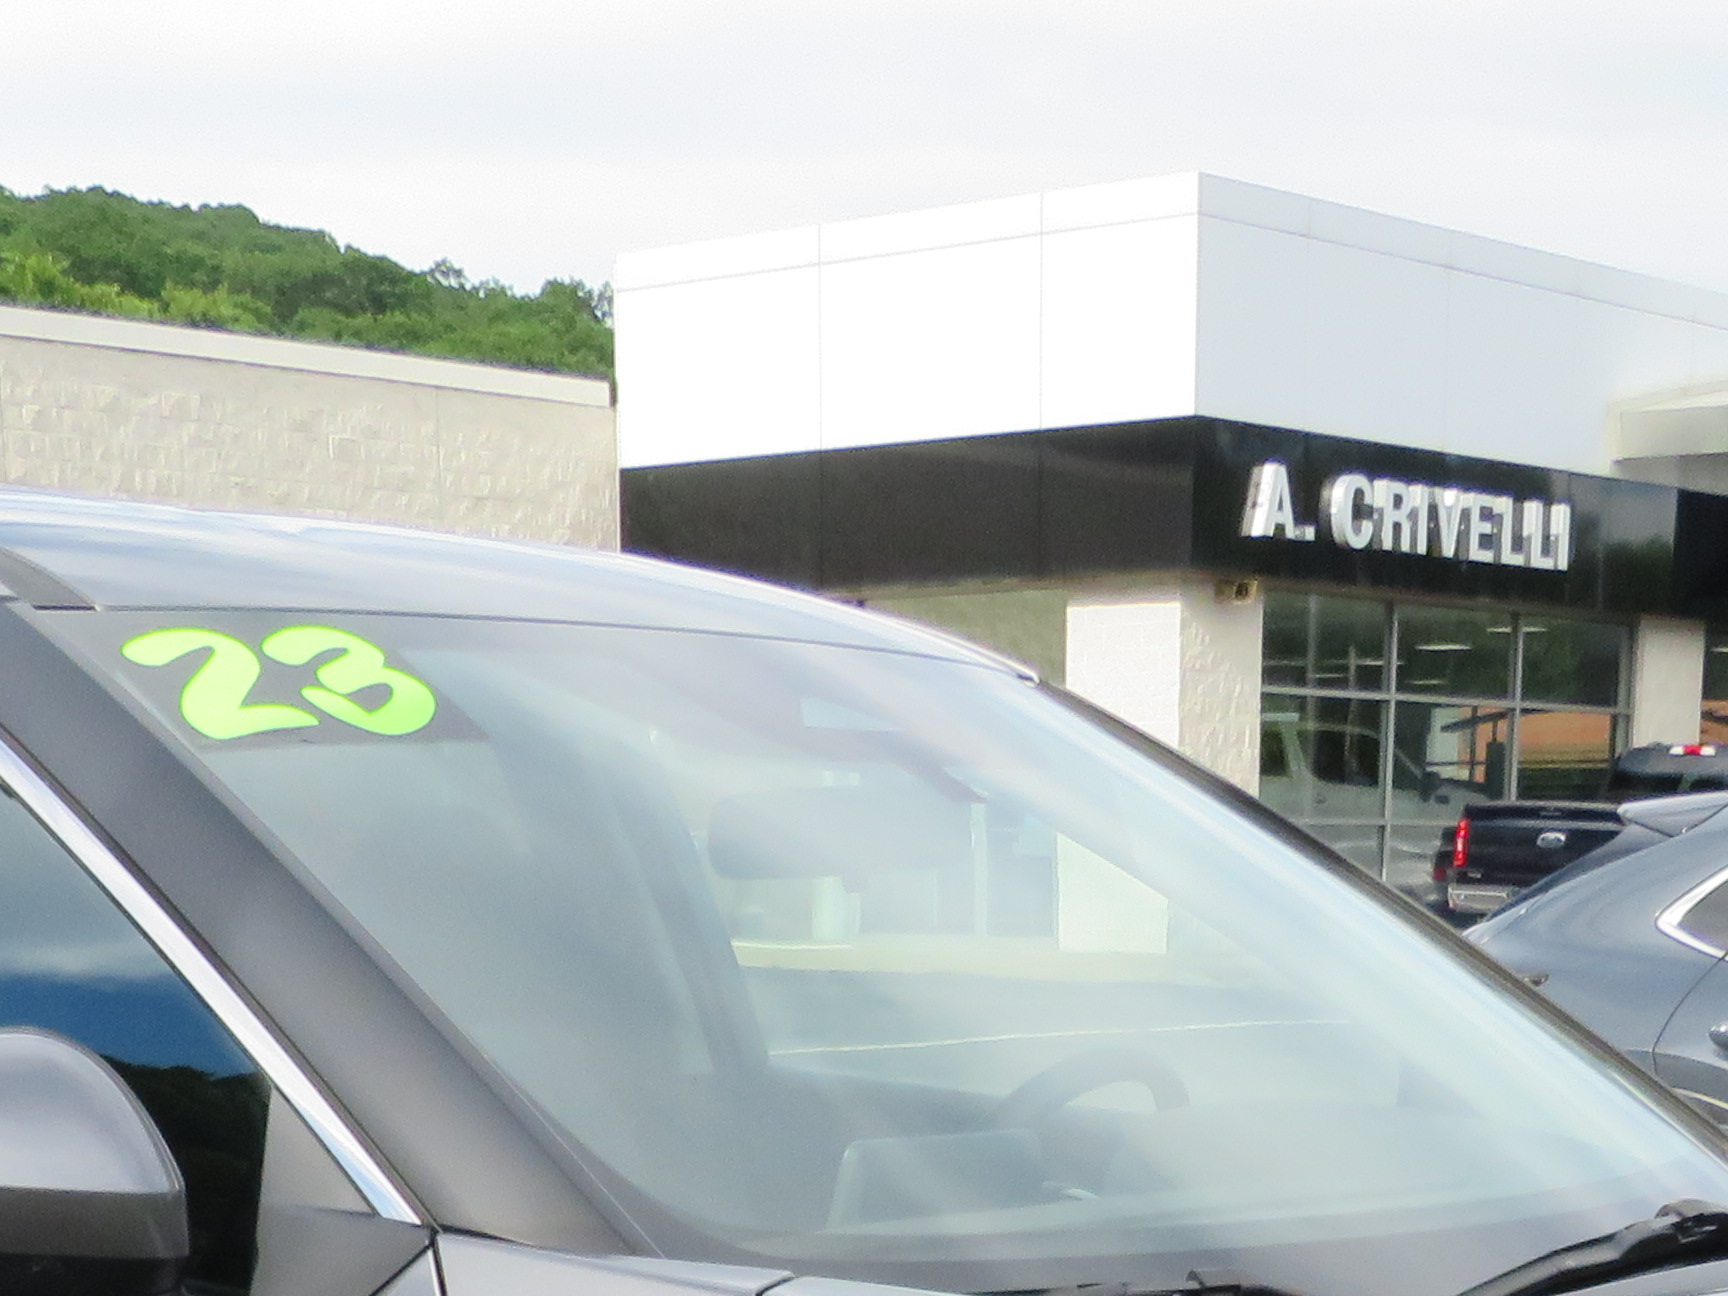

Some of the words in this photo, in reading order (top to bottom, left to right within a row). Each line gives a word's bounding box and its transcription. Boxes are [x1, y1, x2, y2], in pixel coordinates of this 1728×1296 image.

[1247, 461, 1316, 541] A.
[1331, 473, 1571, 572] CRIVELLI
[121, 626, 437, 740] 23
